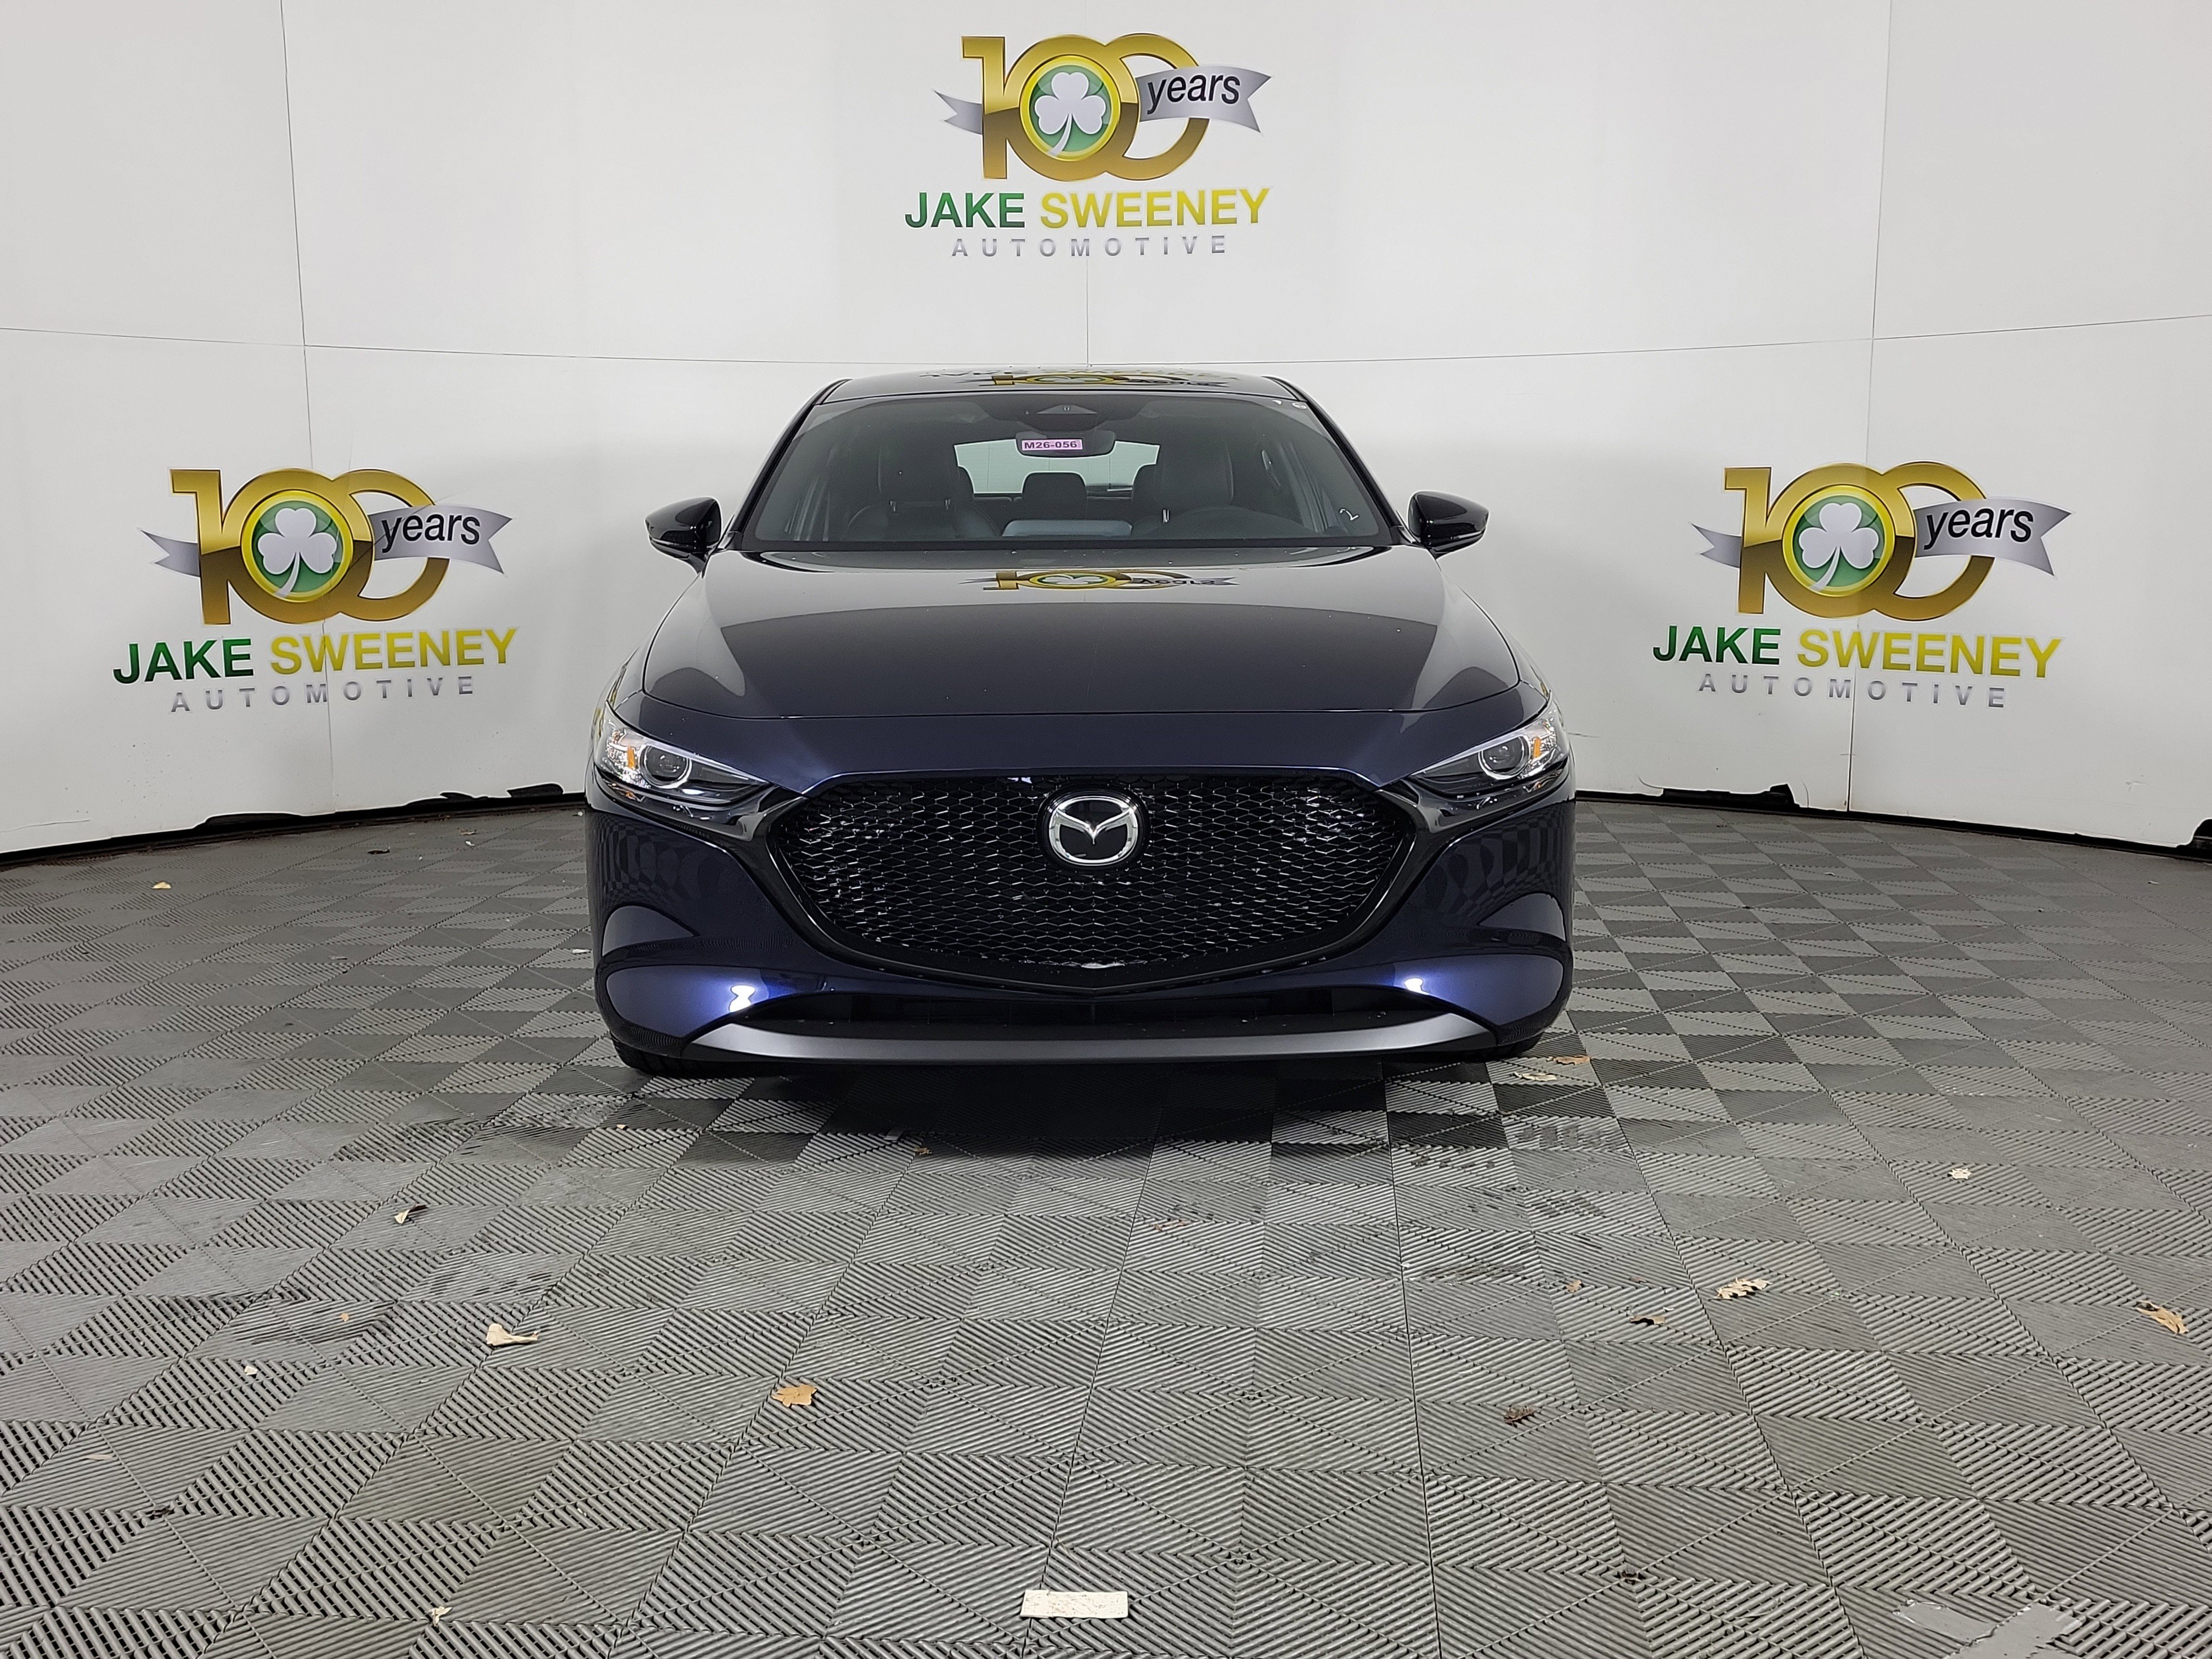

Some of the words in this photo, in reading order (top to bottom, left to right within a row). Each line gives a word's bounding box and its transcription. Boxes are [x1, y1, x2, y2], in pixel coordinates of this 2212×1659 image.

[962, 32, 1210, 182] 100
[1147, 74, 1240, 115] years
[905, 191, 1025, 228] JAKE
[1040, 188, 1270, 229] SWEENEY
[952, 235, 1226, 258] AUTOMOTIVE
[170, 467, 450, 625] 100
[381, 514, 481, 554] years
[1724, 461, 1996, 621] 100
[1924, 508, 2034, 550] years
[113, 638, 255, 684] JAKE
[270, 628, 520, 676] SWEENEY
[1652, 625, 1781, 665] JAKE
[1797, 628, 2062, 678] SWEENEY
[171, 676, 473, 713] AUTOMOTIVE
[1699, 673, 2005, 708] AUTOMOTIVE
